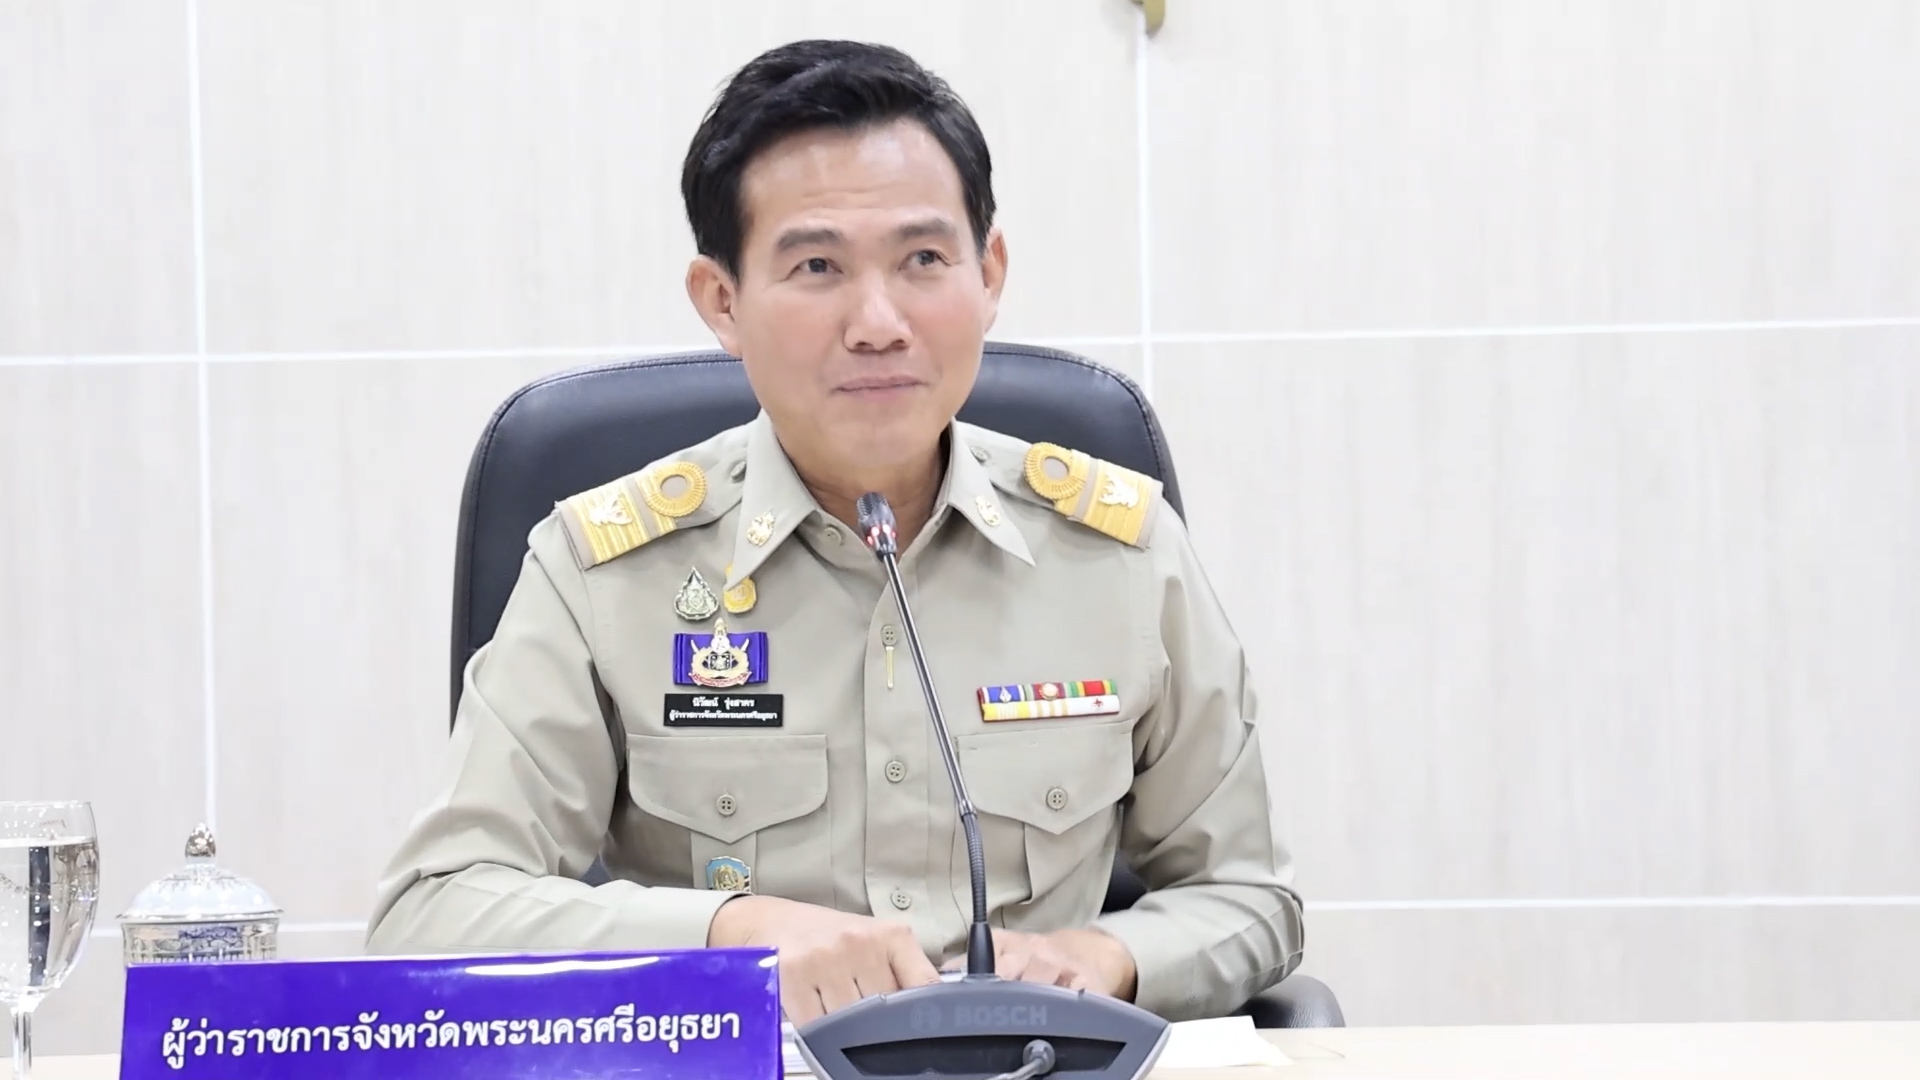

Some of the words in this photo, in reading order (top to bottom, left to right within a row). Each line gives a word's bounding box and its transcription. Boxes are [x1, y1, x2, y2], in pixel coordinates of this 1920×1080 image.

[162, 1002, 740, 1070] ผู้ว่าราชการจังหวัดพระนครศรีอยุธยา
[954, 1005, 1047, 1026] BOSCH
